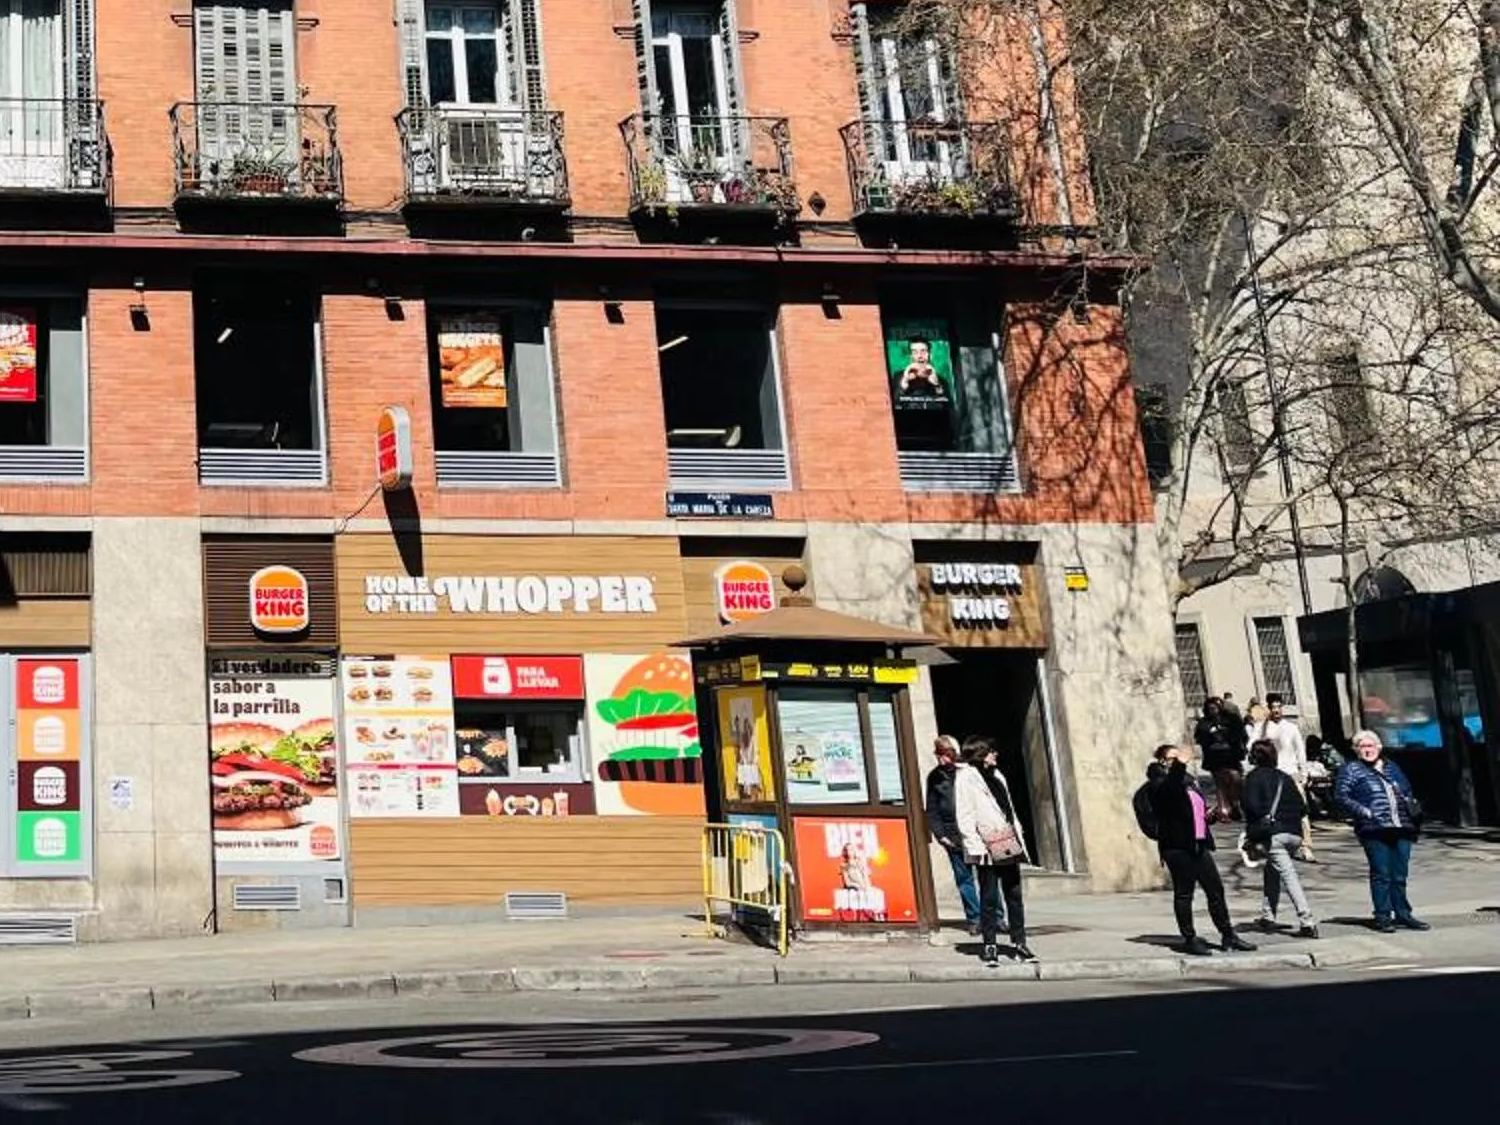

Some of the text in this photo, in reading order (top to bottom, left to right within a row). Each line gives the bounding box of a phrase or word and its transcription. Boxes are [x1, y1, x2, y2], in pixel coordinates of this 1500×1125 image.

[931, 564, 1022, 585] BURGER
[365, 576, 430, 594] HOME
[723, 582, 770, 593] BURGER
[255, 588, 304, 600] BURGER
[433, 576, 657, 613] WHOPPER
[725, 594, 772, 610] KING
[256, 602, 305, 617] KING
[365, 595, 437, 612] OF THE
[952, 598, 1011, 620] KING
[232, 658, 322, 674] verdadero
[516, 666, 546, 676] PARA
[213, 678, 276, 694] sabor a
[516, 677, 559, 688] LLEVAR
[213, 698, 301, 717] la parrilla
[35, 786, 66, 799] KING
